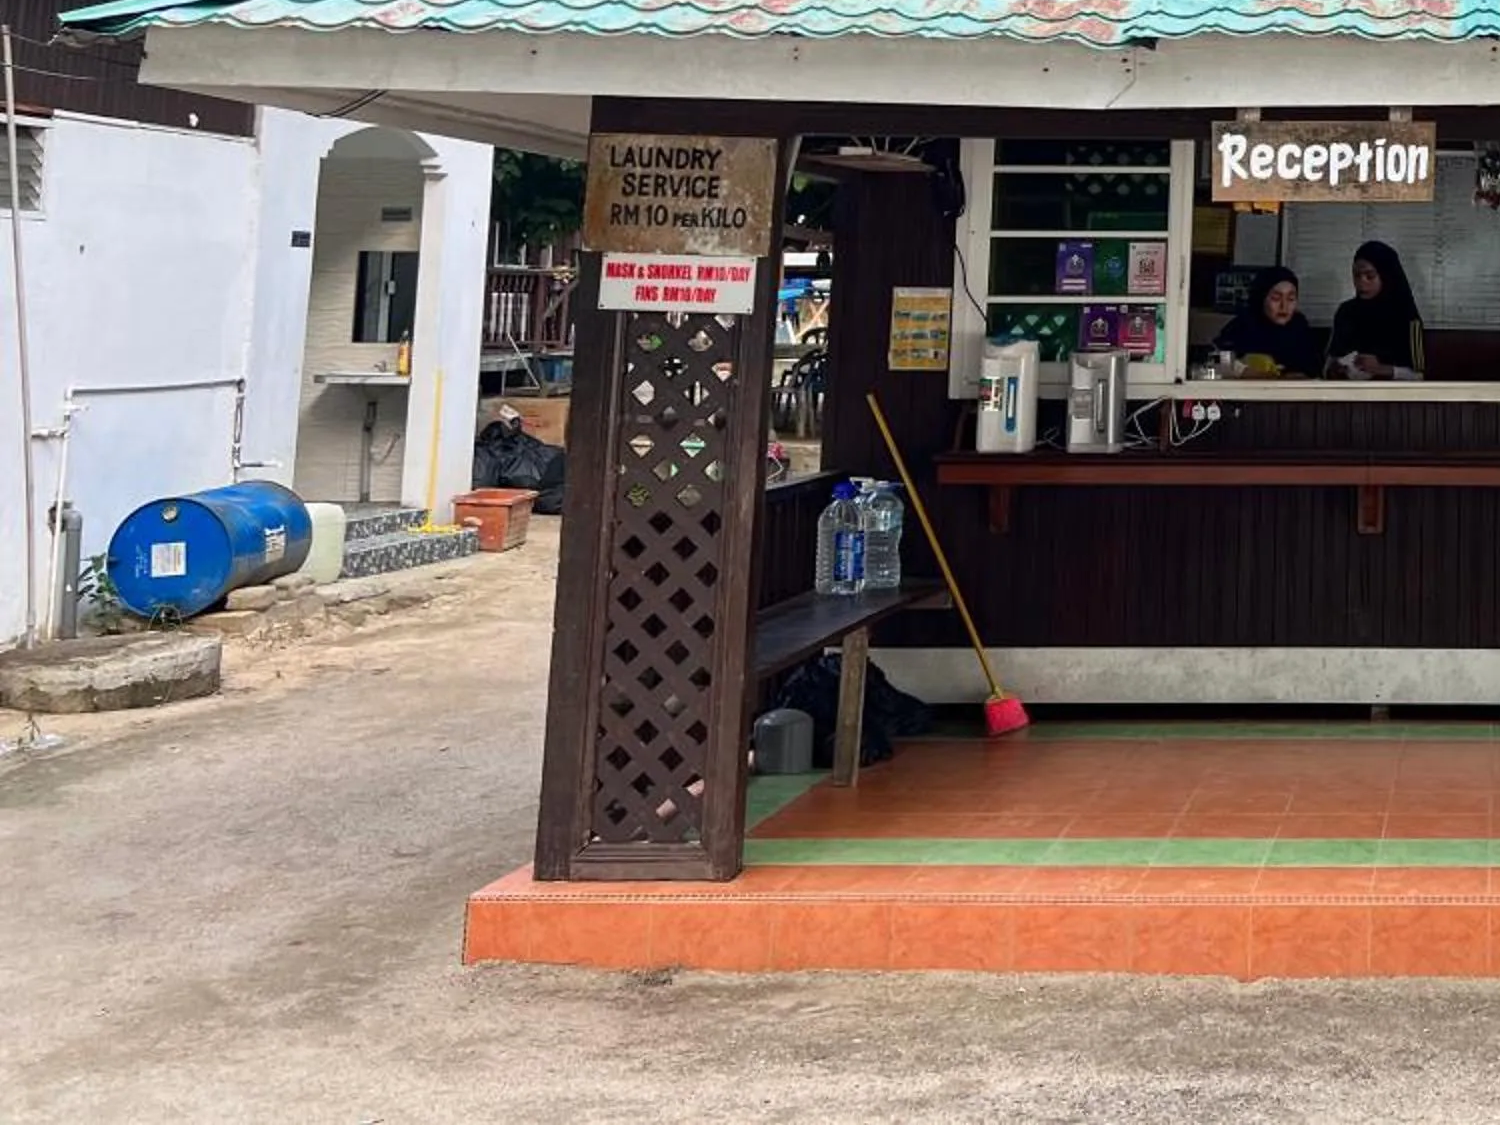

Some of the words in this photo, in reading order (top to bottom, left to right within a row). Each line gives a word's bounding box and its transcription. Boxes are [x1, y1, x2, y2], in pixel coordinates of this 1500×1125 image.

[610, 145, 722, 171] LAUNDRY
[1218, 132, 1429, 188] Reception
[621, 173, 721, 199] SERVICE
[609, 203, 639, 226] RM
[645, 204, 669, 227] 10
[672, 212, 700, 228] PER
[701, 207, 747, 229] KILO
[606, 262, 637, 279] MASK
[638, 265, 646, 279] &
[647, 264, 692, 281] SNORKEL
[635, 285, 659, 302] FINS
